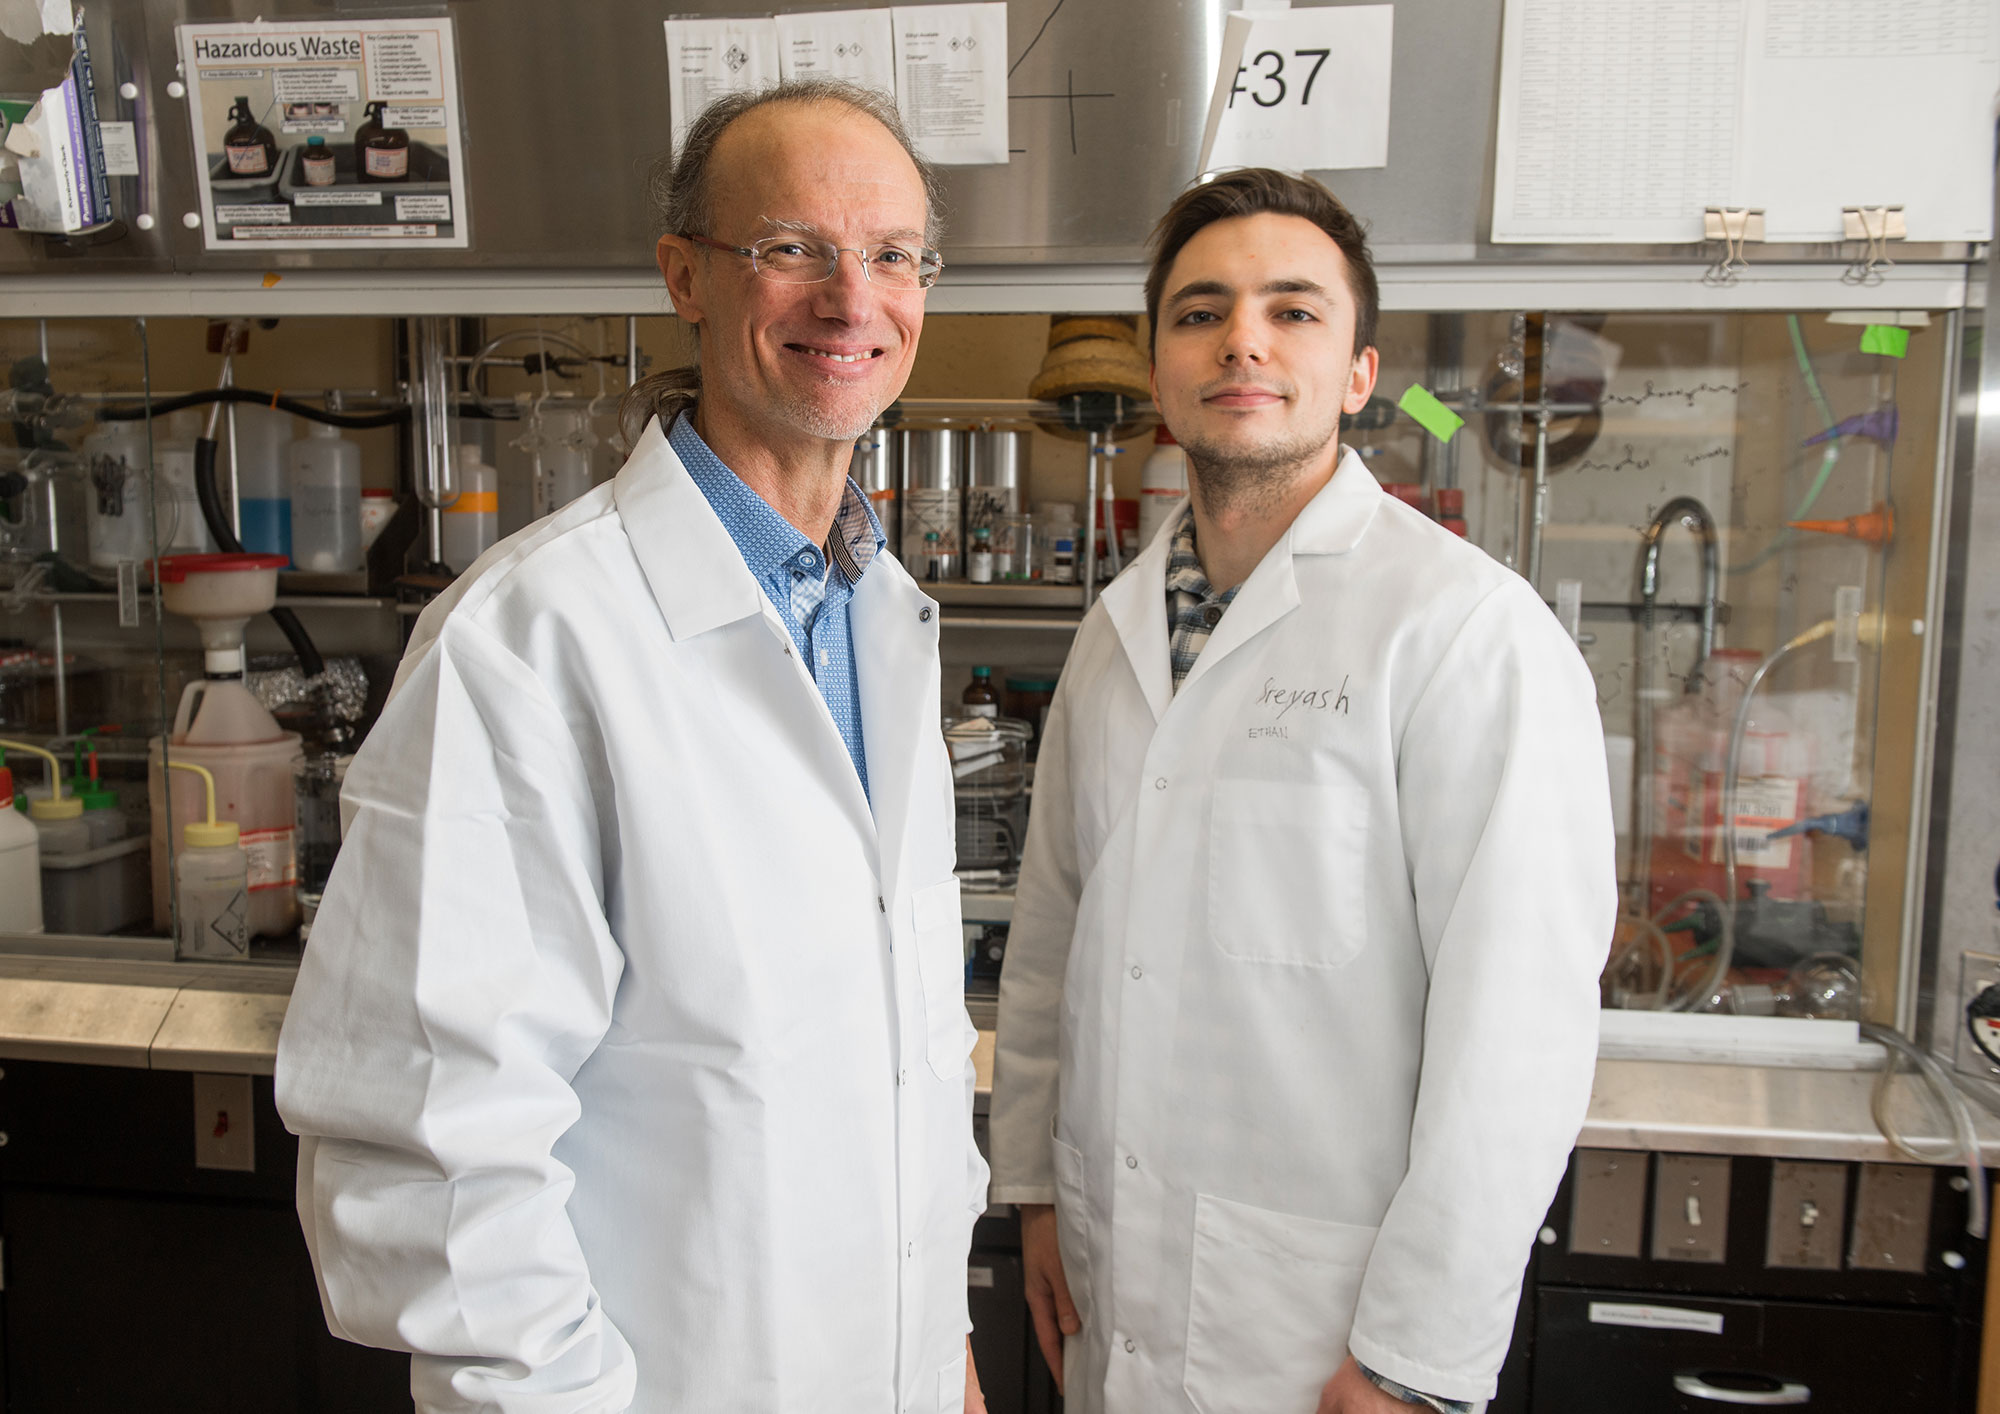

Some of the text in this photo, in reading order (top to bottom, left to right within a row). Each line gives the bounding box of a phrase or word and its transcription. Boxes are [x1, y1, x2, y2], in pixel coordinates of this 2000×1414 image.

[195, 36, 361, 58] Hazardous Waste
[60, 144, 73, 208] Kimberly-Clark
[1248, 726, 1288, 739] ETHAN
